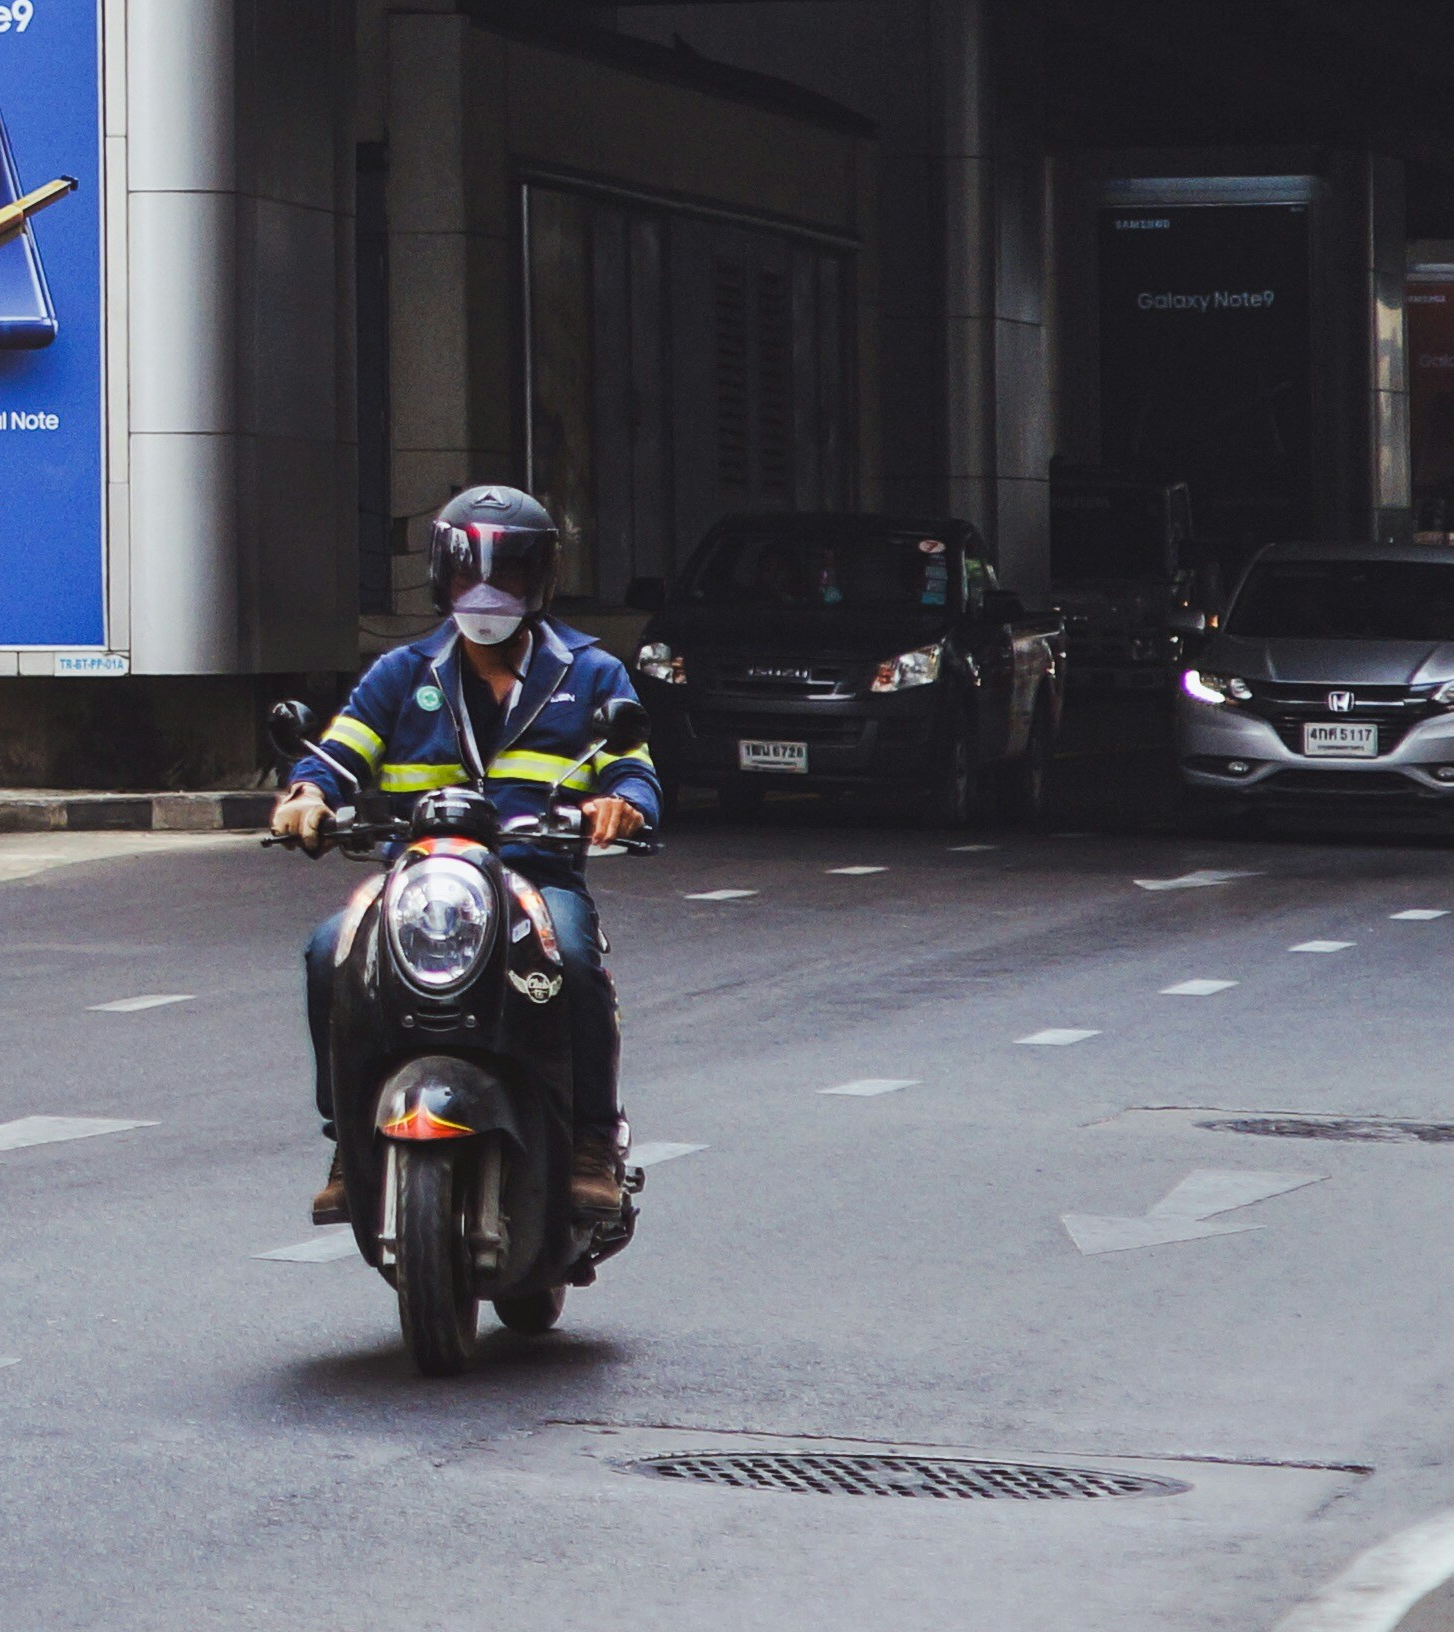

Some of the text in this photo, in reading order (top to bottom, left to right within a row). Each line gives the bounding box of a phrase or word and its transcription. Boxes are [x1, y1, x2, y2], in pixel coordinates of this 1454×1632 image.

[1137, 289, 1275, 313] Galaxy Note9
[11, 411, 59, 430] Note
[1340, 729, 1372, 741] 5117
